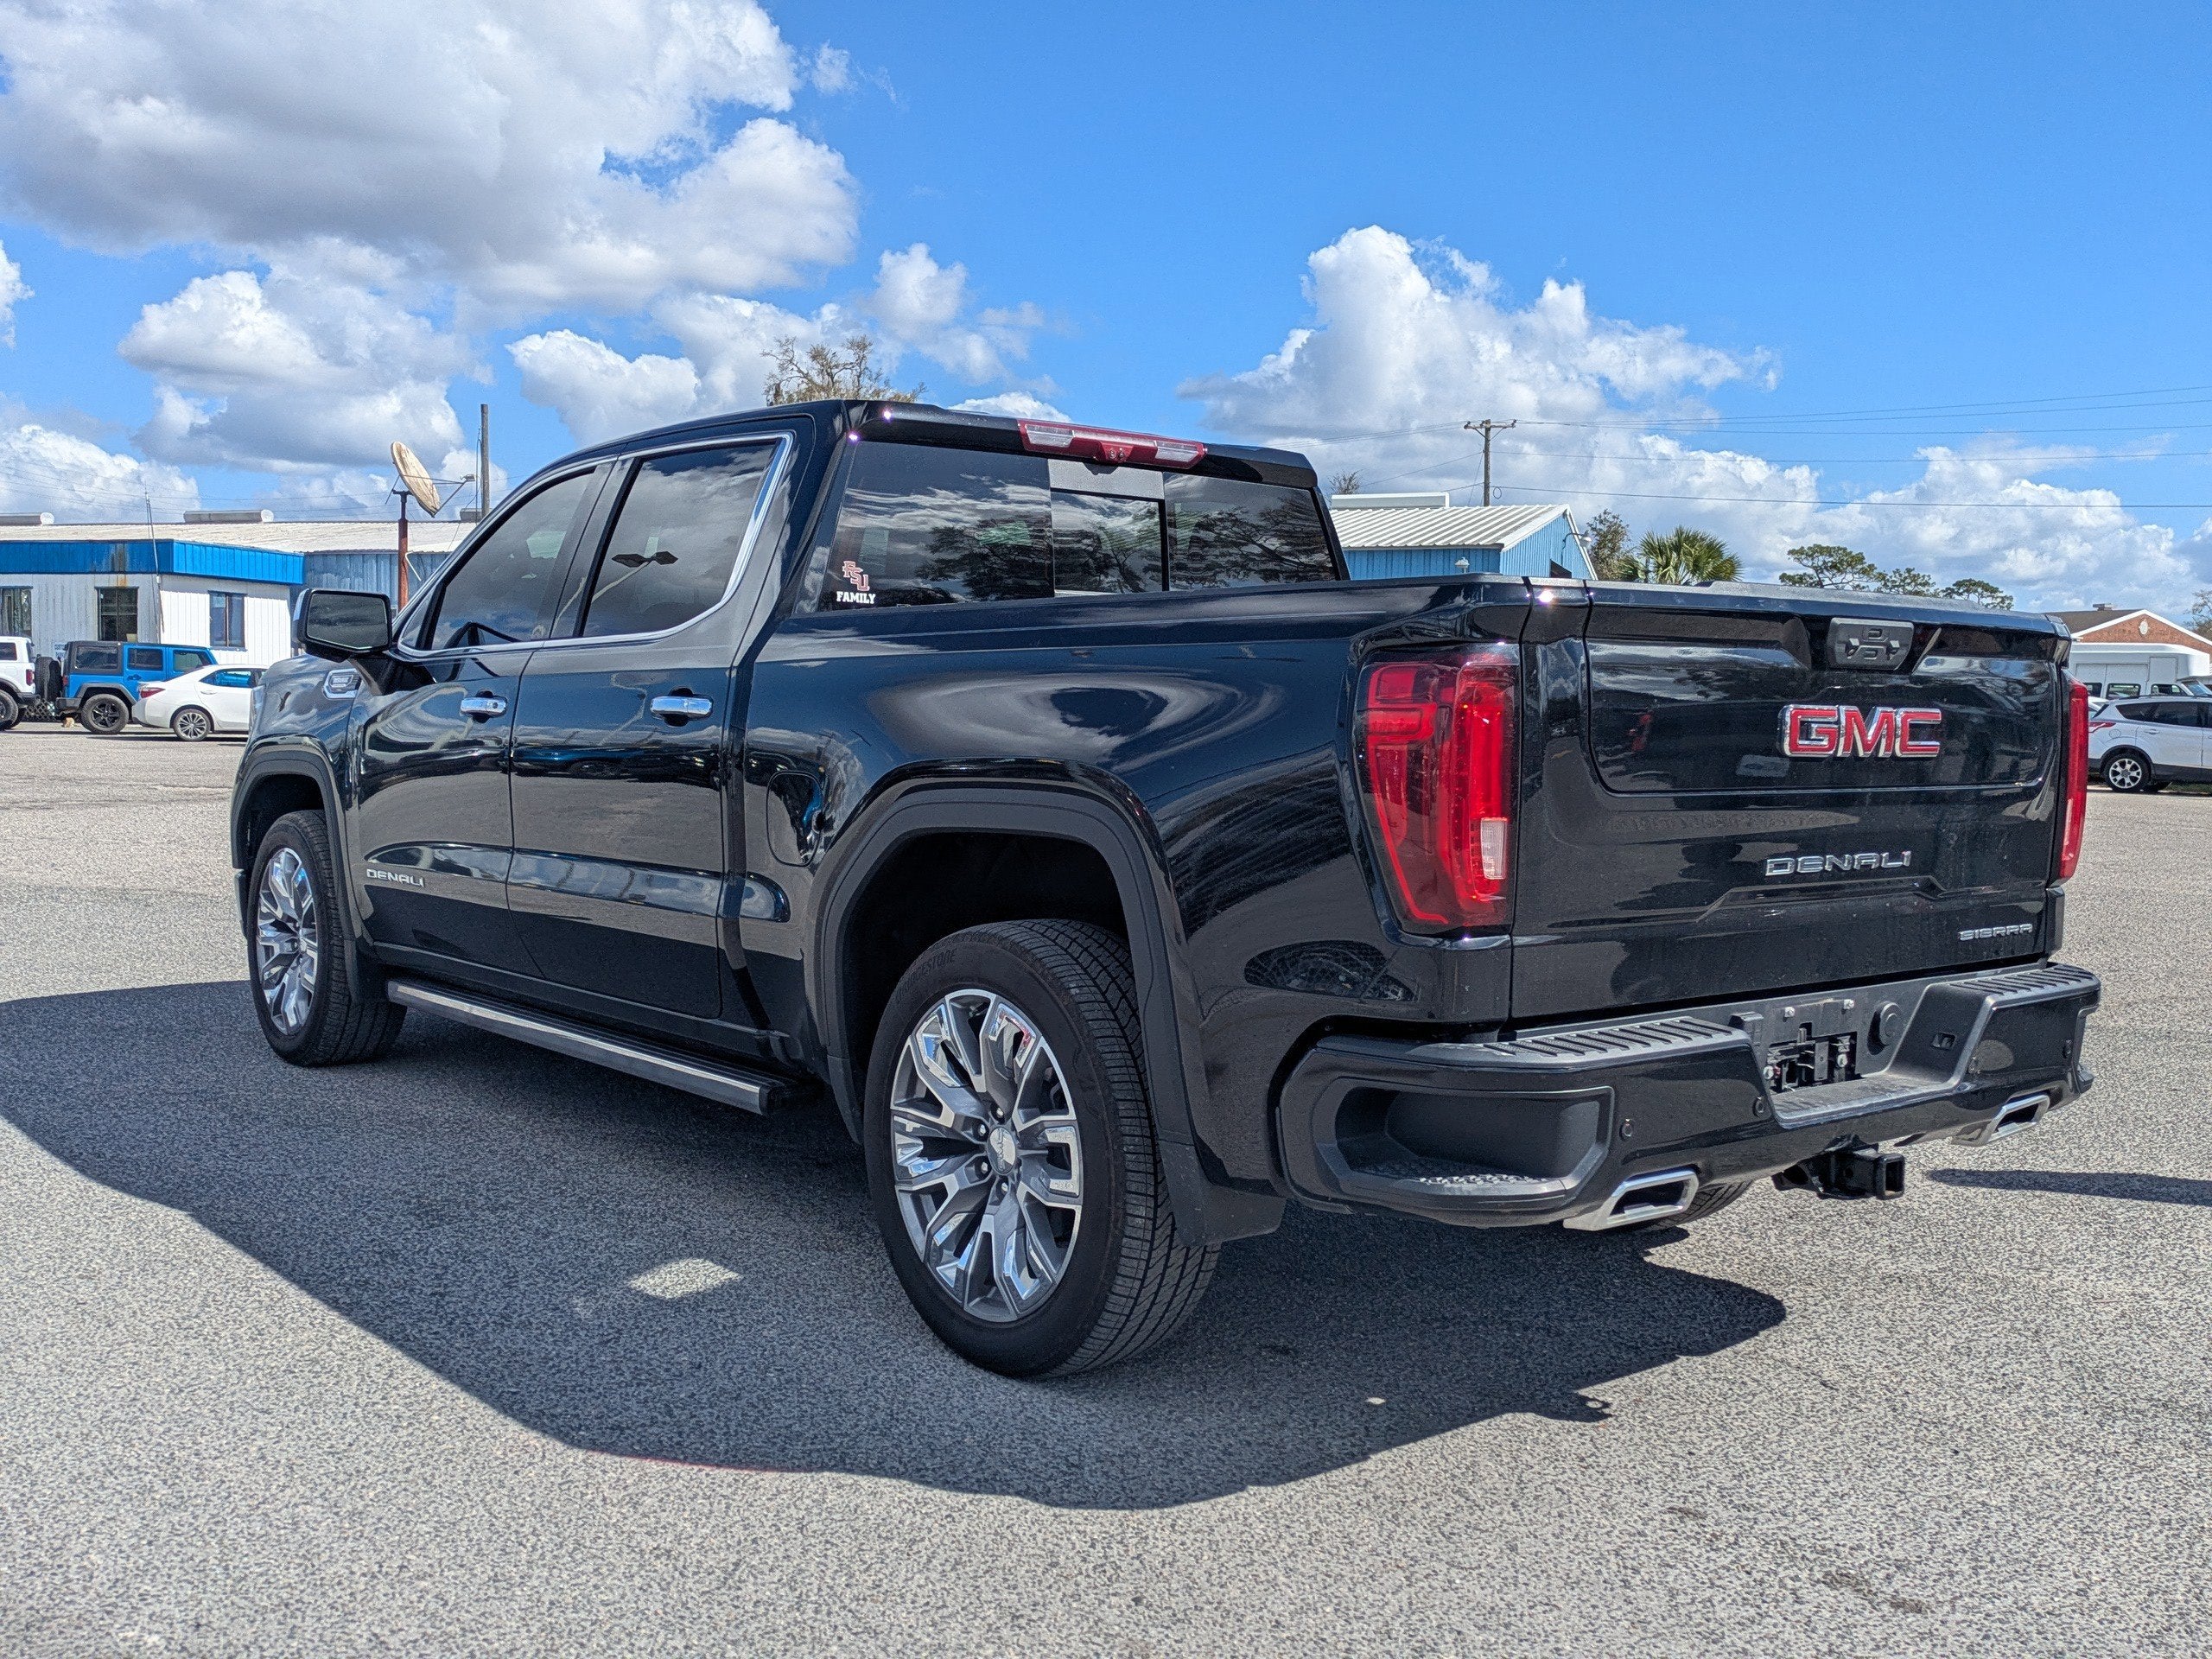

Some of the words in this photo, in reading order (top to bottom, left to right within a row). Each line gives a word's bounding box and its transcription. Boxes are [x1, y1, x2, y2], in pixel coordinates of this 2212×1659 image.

[836, 591, 876, 605] FAMILY
[1779, 703, 1942, 758] GMC
[1764, 850, 1912, 877] DENALI
[365, 868, 424, 887] DENALI
[1958, 923, 2033, 942] SIERRA
